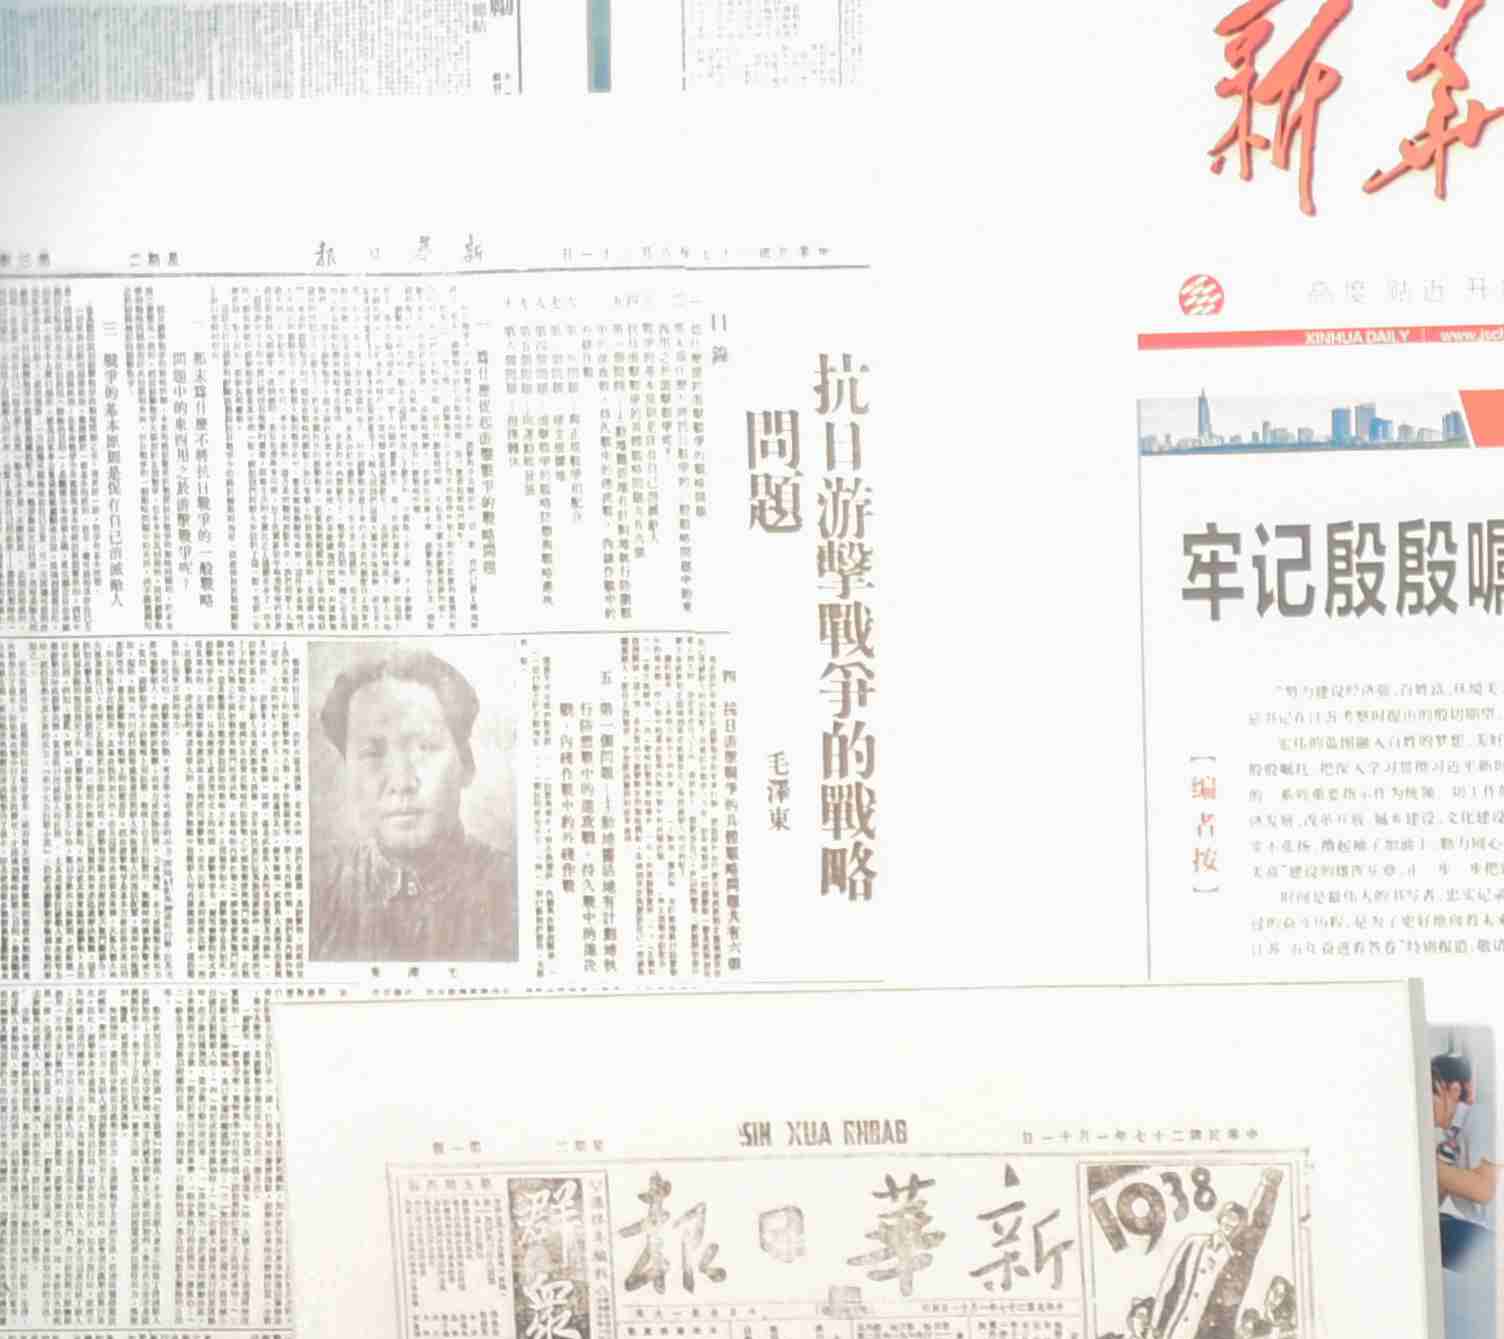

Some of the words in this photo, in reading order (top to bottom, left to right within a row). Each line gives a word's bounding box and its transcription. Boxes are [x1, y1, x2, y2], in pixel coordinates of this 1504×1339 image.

[745, 409, 803, 534] 問題
[813, 352, 878, 902] 抗日游擊戰爭的戰略
[766, 750, 791, 832] 毛澤東
[616, 1162, 1076, 1297] 新華日報
[1090, 1166, 1219, 1256] 1938
